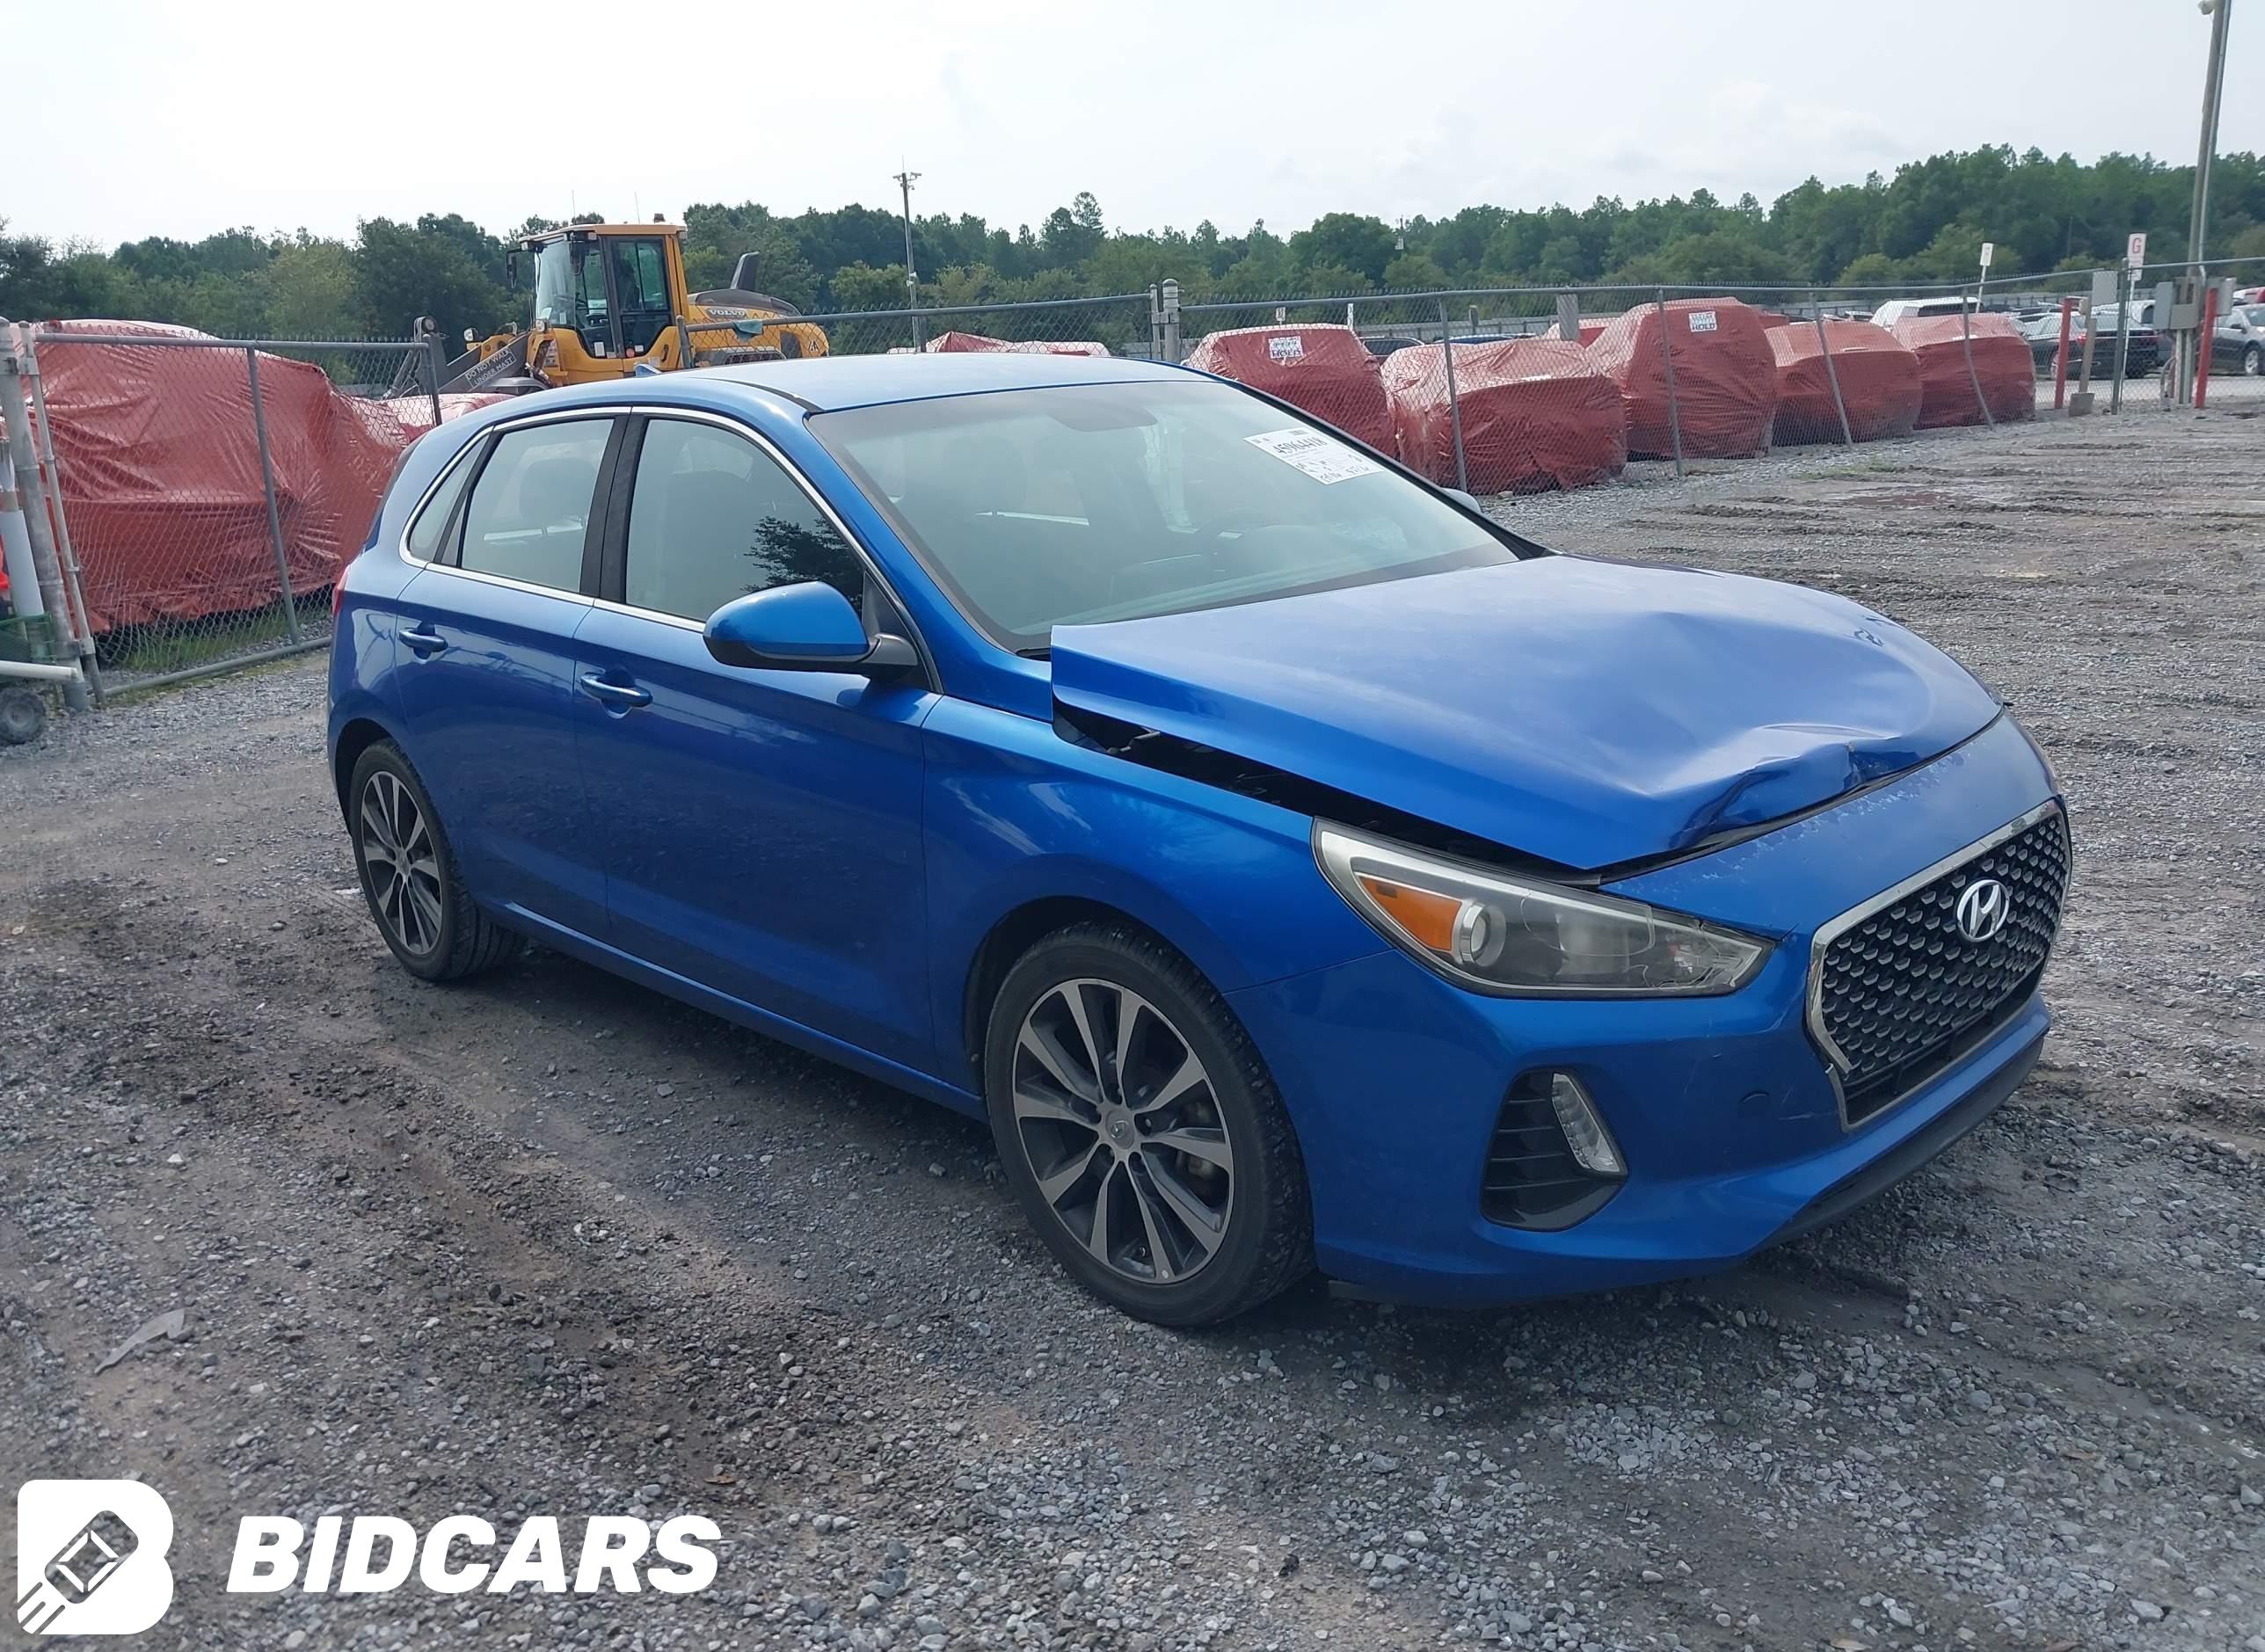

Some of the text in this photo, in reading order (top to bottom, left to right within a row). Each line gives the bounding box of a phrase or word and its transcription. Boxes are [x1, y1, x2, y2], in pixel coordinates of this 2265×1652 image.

[2131, 237, 2142, 254] G
[465, 370, 477, 381] DO
[476, 357, 492, 374] NOT
[474, 356, 513, 384] UNDER MAST
